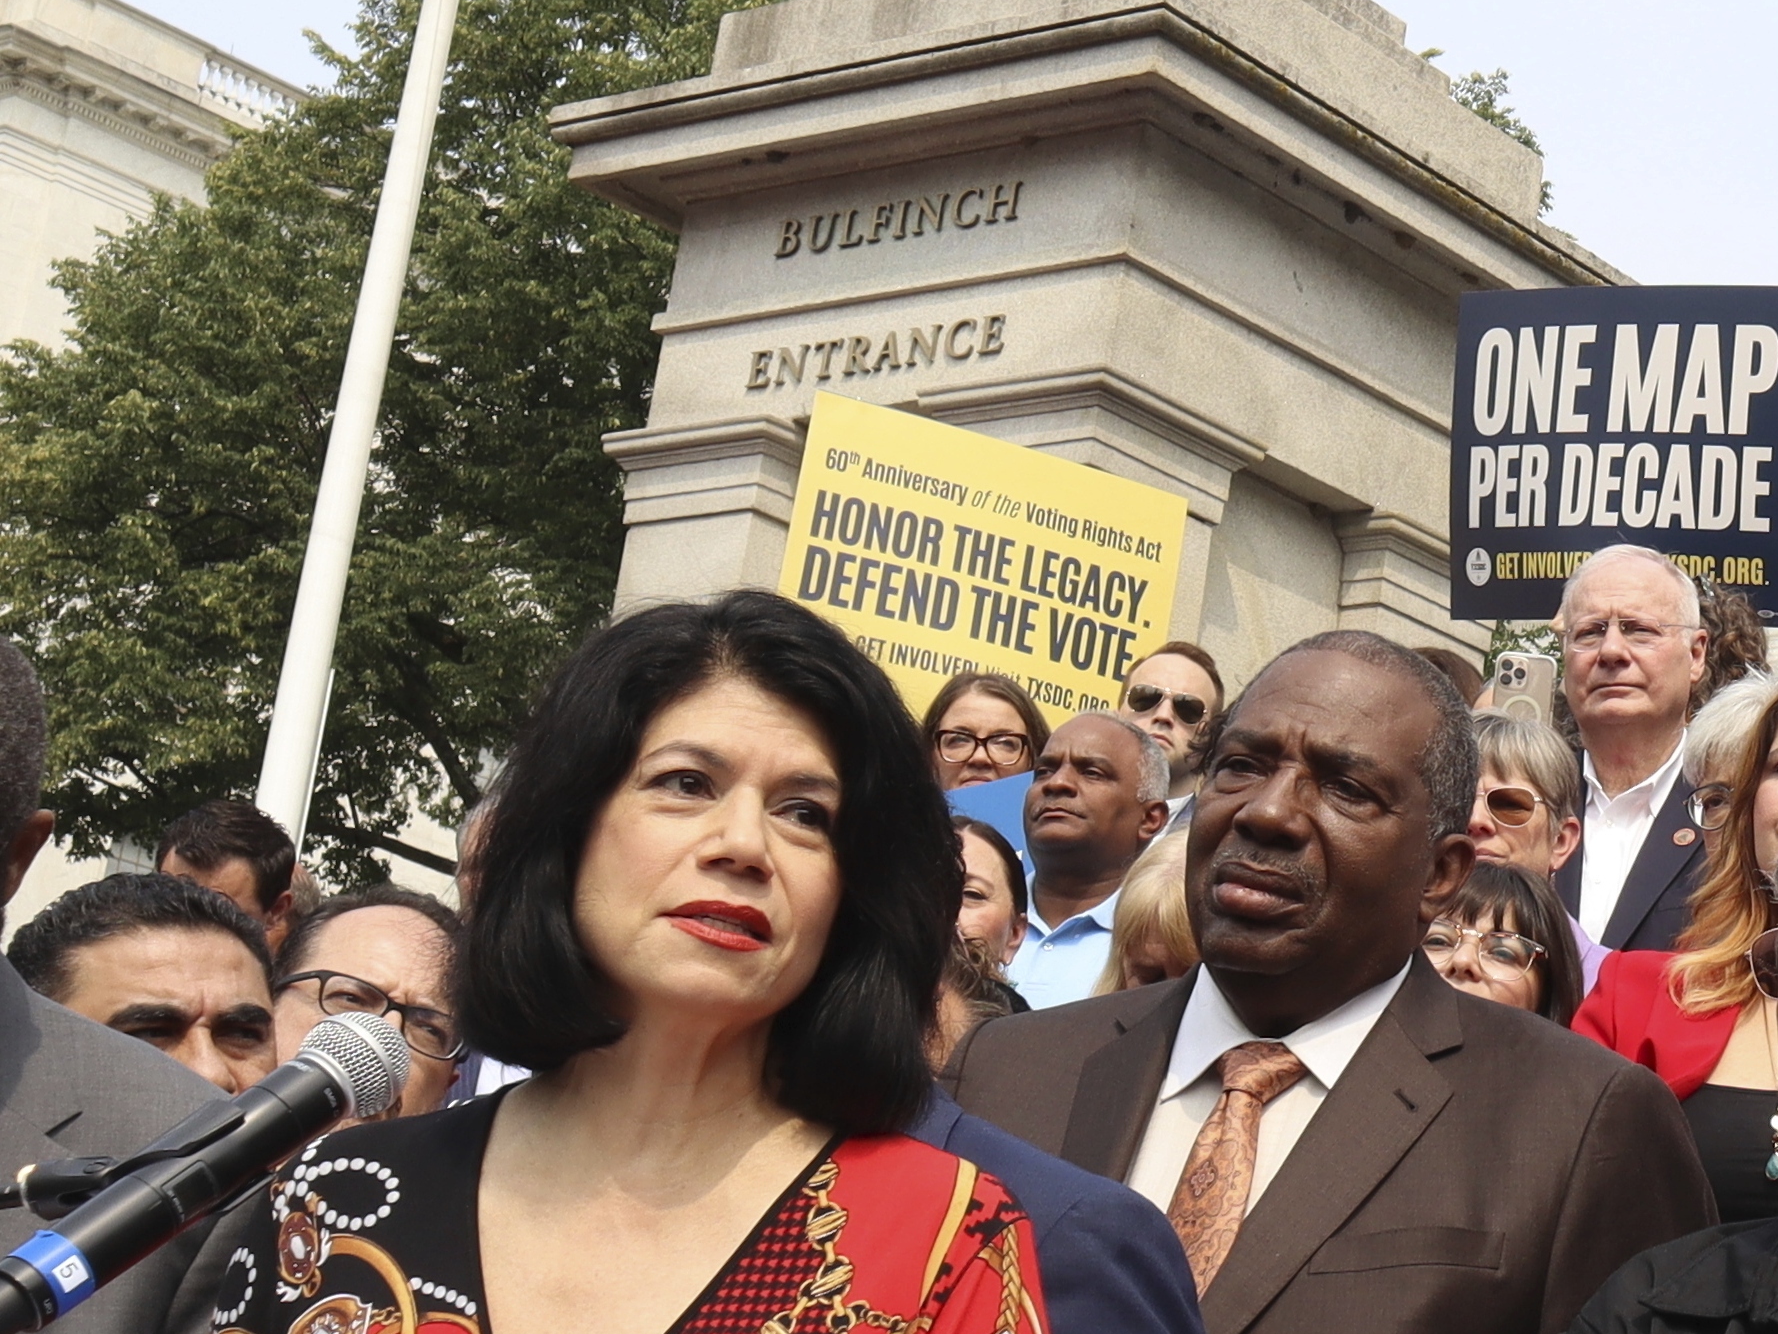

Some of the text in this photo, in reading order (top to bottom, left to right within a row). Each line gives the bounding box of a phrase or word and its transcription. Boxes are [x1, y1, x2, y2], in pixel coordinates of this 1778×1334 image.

[774, 180, 1023, 259] BULFINCH
[745, 313, 1006, 390] ENTRANCE
[1473, 323, 1598, 437] ONE
[825, 447, 1162, 564] 60th Anniversary of the Voting Rights Act
[1468, 442, 1773, 533] PER DECADE
[809, 488, 1151, 629] HONOR THE LEGACY.
[1496, 552, 1520, 580] GET
[798, 544, 1138, 683] DEFEND THE VOTE
[60, 1262, 79, 1279] 5
